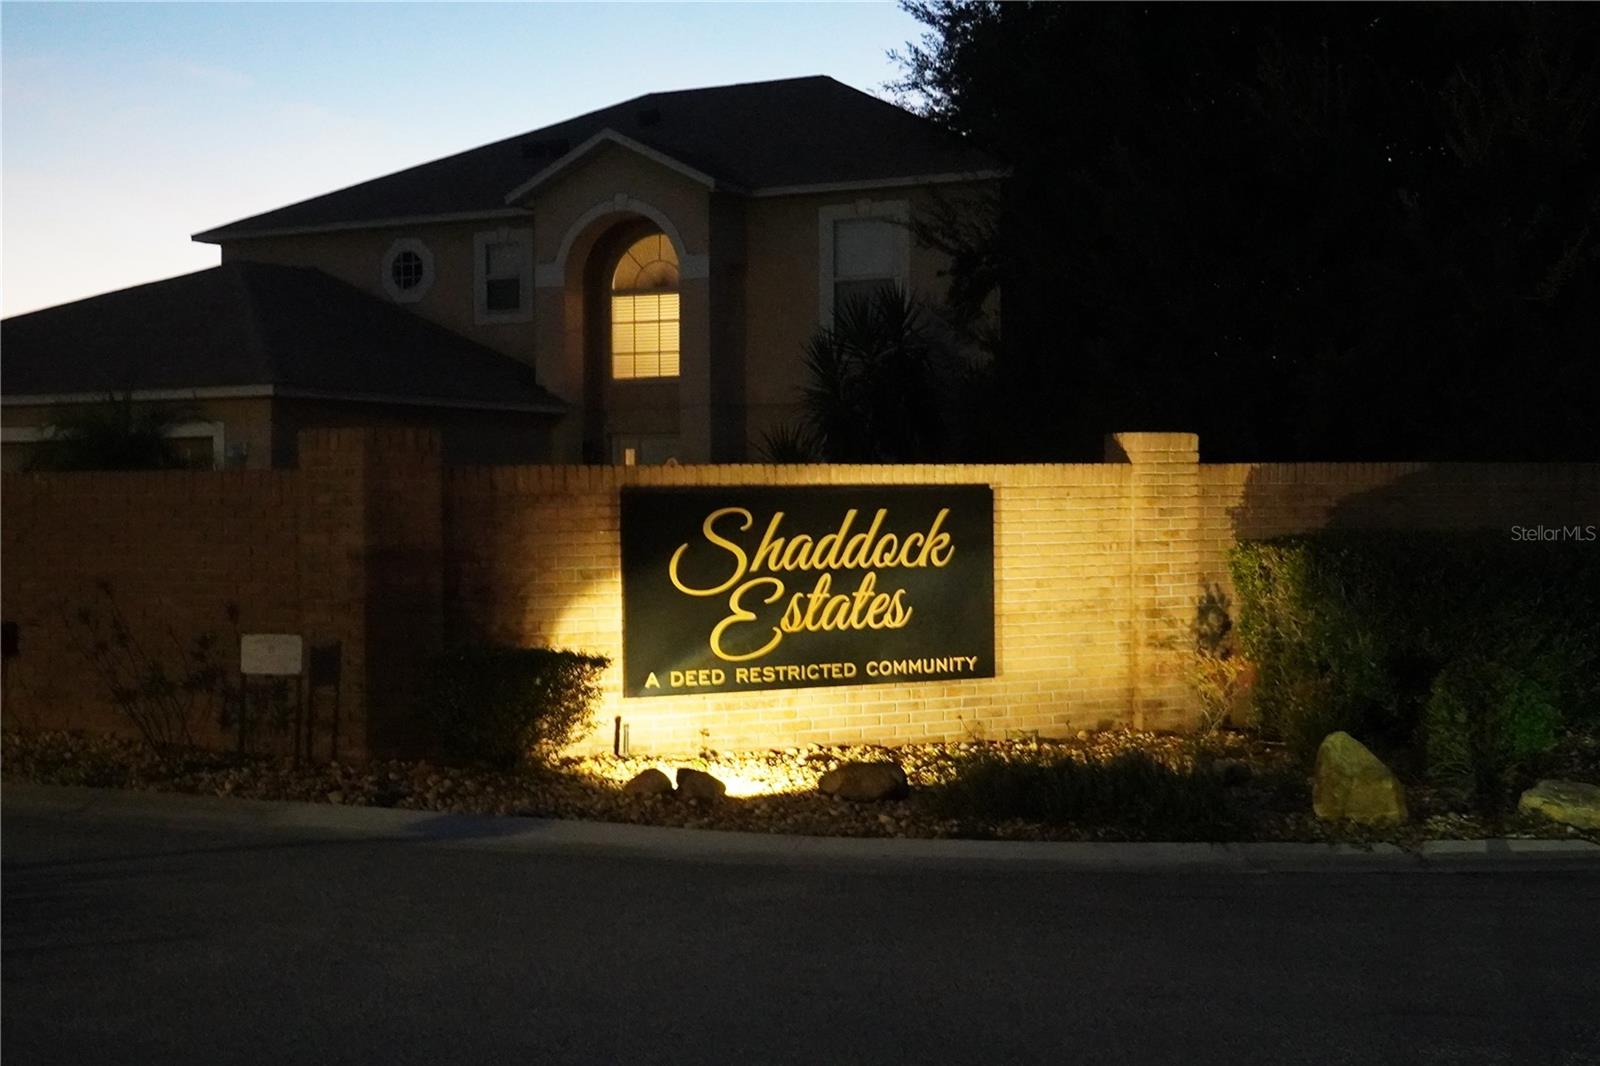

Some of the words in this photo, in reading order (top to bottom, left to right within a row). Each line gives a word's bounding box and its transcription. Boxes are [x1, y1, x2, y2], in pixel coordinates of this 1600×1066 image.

[669, 507, 955, 597] Shaddock
[710, 571, 913, 662] Estates
[644, 671, 661, 689] A
[670, 669, 726, 688] DEED
[735, 662, 857, 684] RESTRICTED
[866, 656, 978, 677] COMMUNITY
